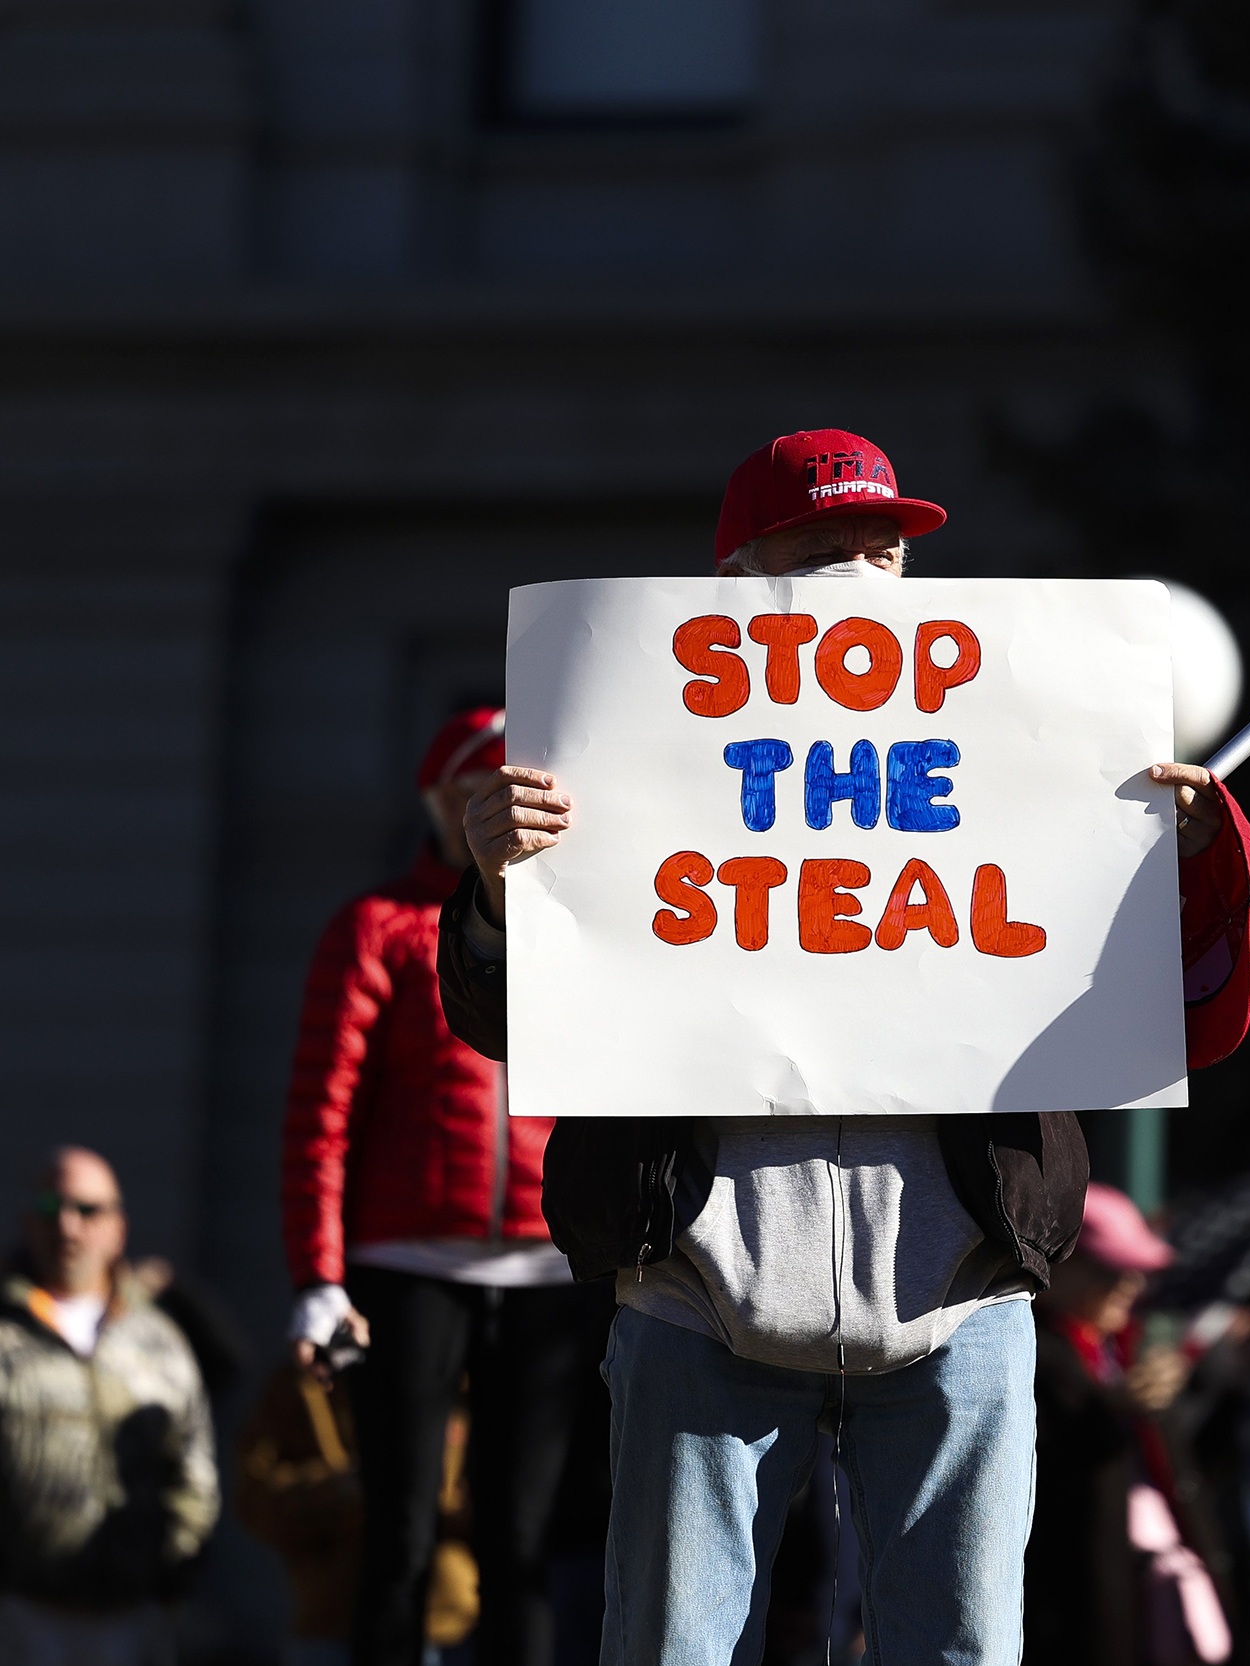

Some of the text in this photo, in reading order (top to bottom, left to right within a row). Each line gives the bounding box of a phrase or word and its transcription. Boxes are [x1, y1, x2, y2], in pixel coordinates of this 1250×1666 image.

[806, 450, 891, 486] I'M A
[807, 480, 895, 501] TRUMPSTER
[672, 613, 982, 719] STOP
[722, 738, 962, 833] THE
[651, 850, 1047, 959] STEAL
